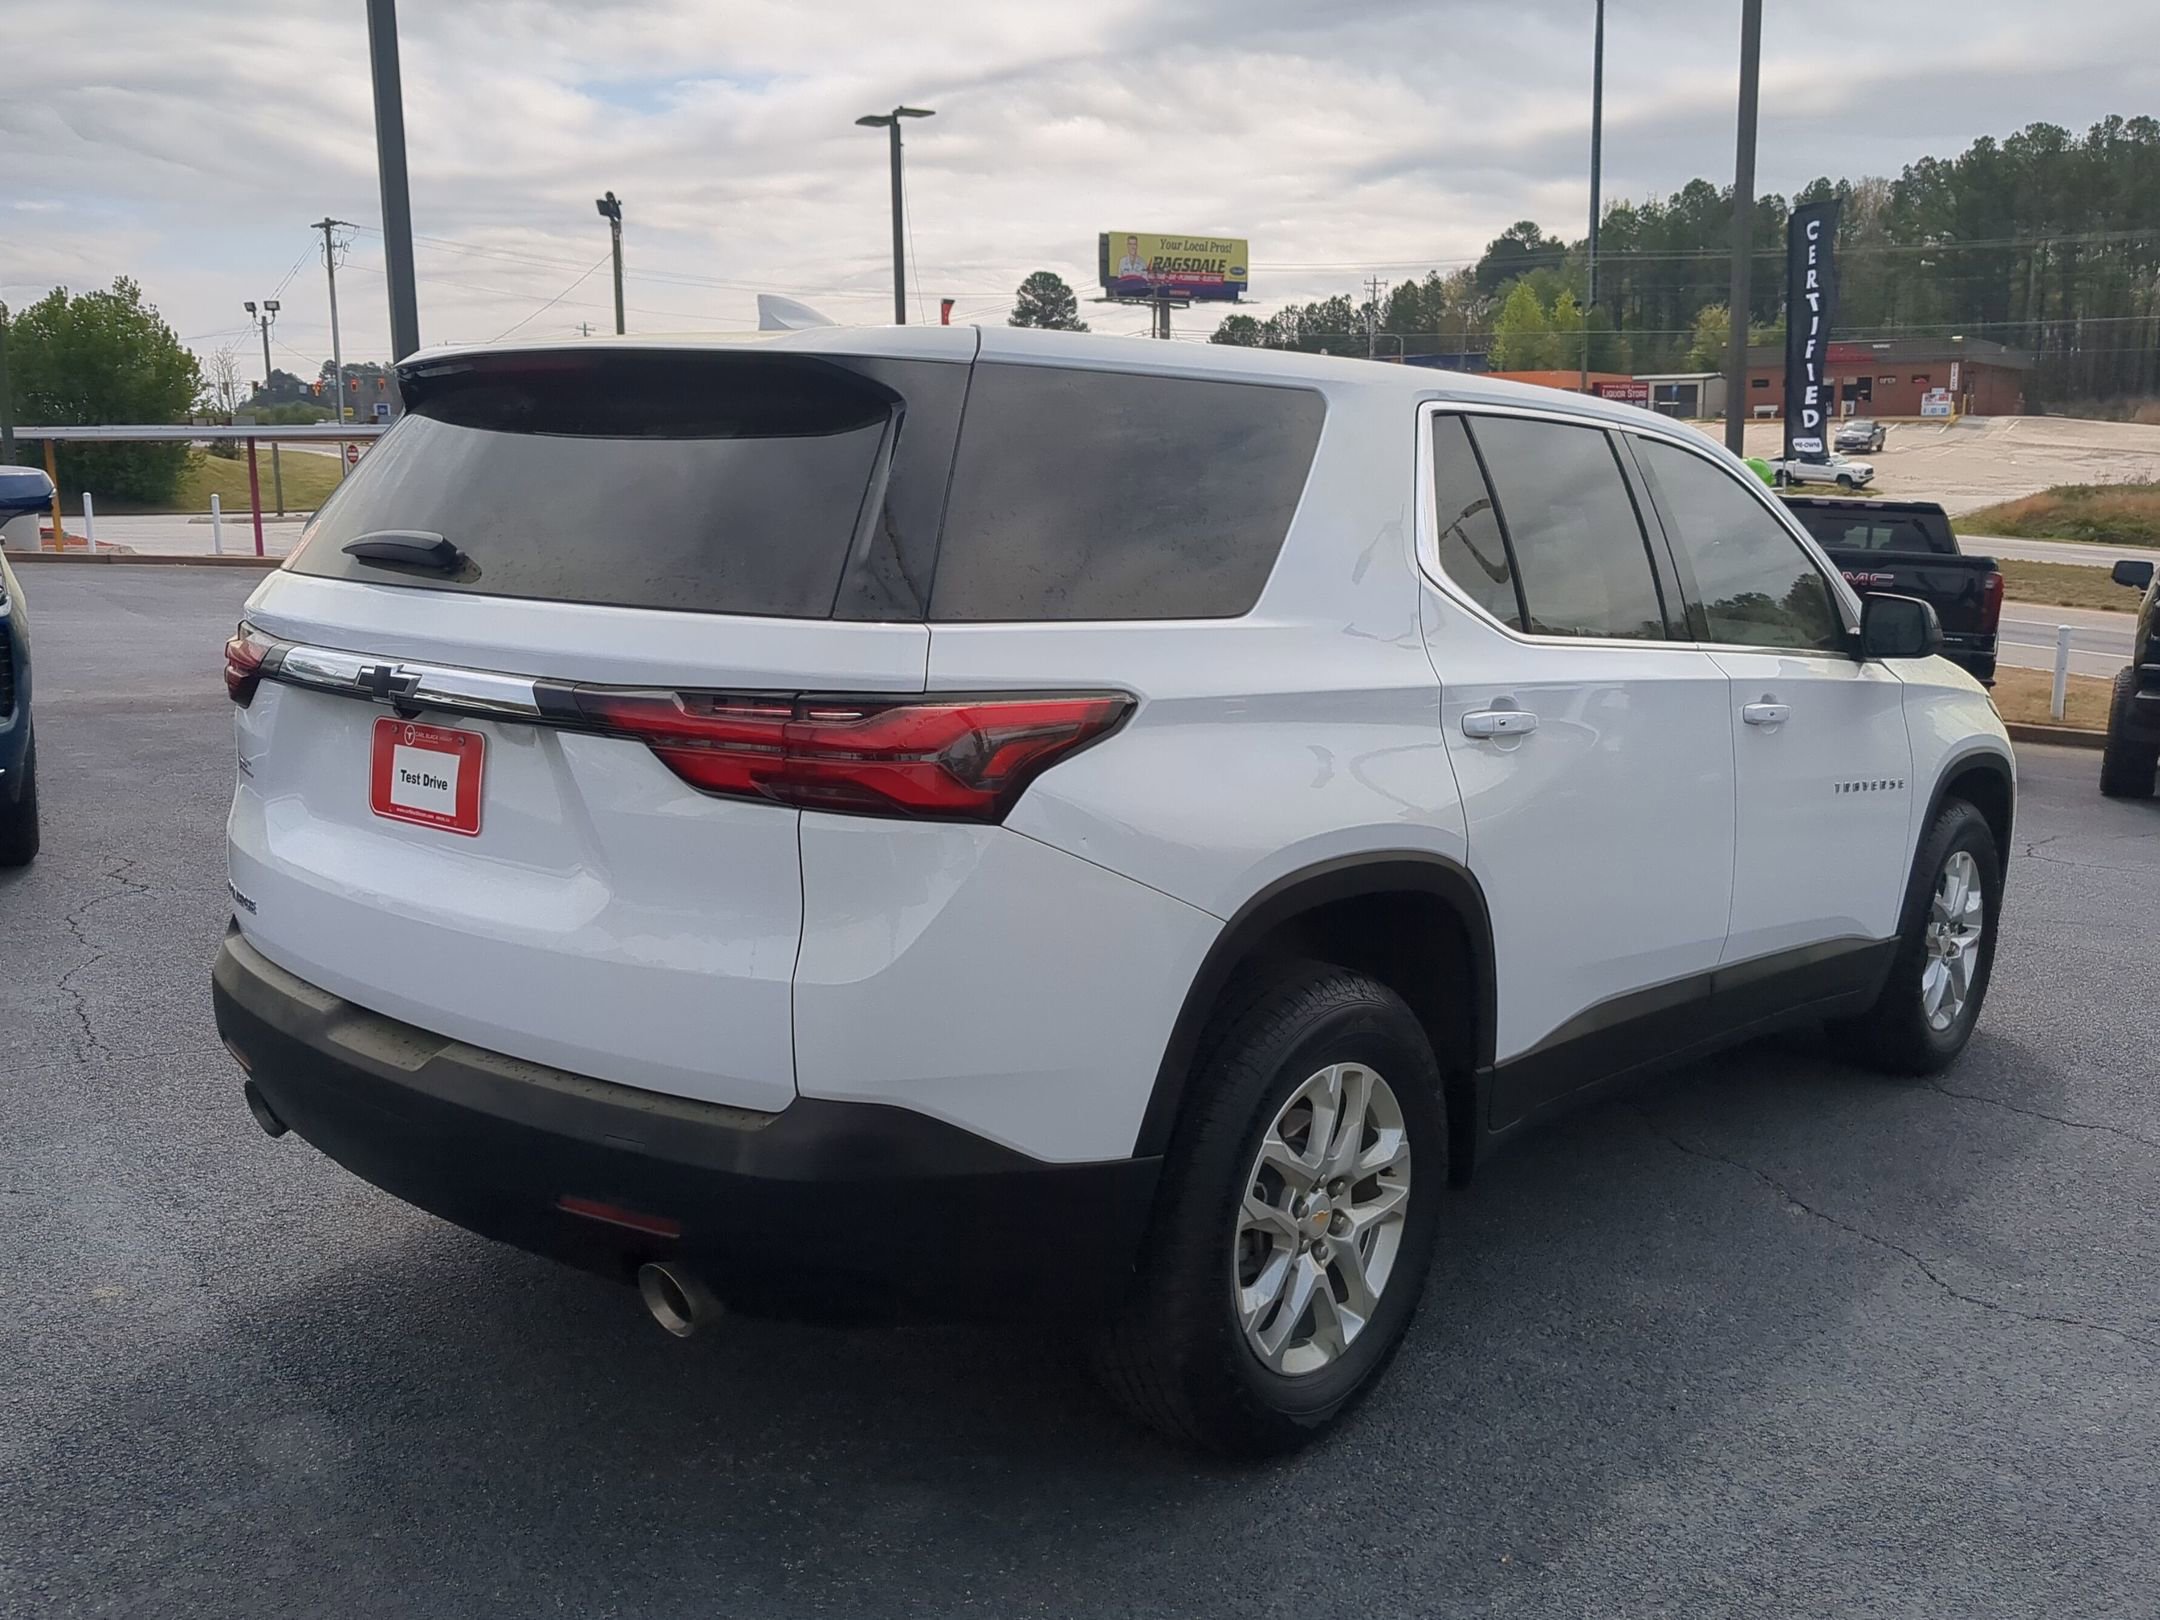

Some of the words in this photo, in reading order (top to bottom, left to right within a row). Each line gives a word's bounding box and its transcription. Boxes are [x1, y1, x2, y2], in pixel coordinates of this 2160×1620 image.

[1159, 238, 1182, 251] Your
[1183, 240, 1208, 253] Local
[1209, 242, 1233, 254] Pros!
[1152, 255, 1227, 273] RAGSDALE
[1802, 220, 1820, 428] CERTIFIED
[1841, 571, 1894, 587] MC
[400, 769, 420, 786] Test
[423, 774, 448, 790] Drive
[1834, 779, 1904, 794] TRAVERSE
